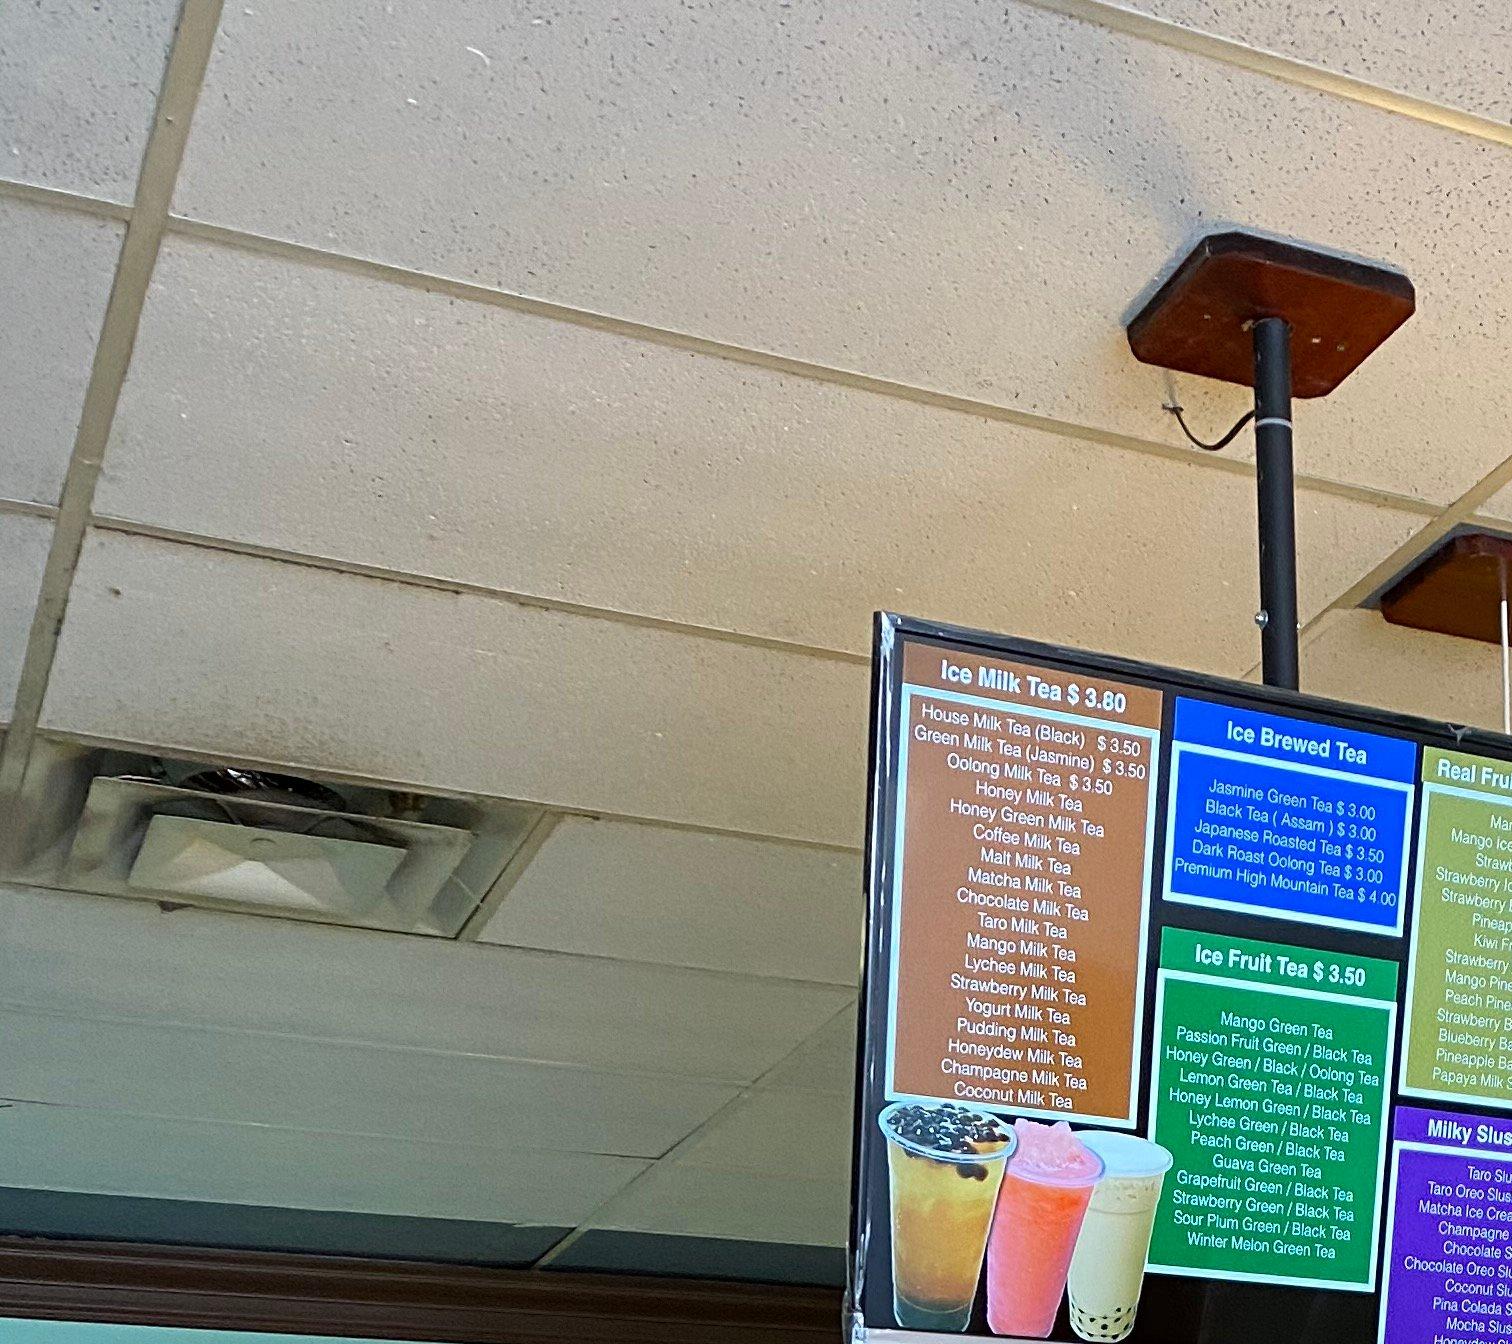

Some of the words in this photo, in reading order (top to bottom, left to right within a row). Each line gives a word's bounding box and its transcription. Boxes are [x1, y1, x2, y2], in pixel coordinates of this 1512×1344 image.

[941, 659, 973, 684] Ice
[977, 665, 1020, 695] Milk
[1027, 675, 1061, 702] Tea
[1066, 683, 1079, 706] $
[1084, 685, 1126, 713] 3.80
[1227, 721, 1254, 742] Ice
[1260, 728, 1330, 757] Brewed
[1336, 741, 1368, 764] Tea
[1437, 760, 1475, 783] Real
[975, 780, 1017, 803] Honey
[1020, 788, 1050, 809] Milk
[1054, 794, 1083, 813] Tea
[1208, 779, 1263, 802] Jasmine
[1268, 790, 1306, 810] Green
[1311, 796, 1333, 813] Tea
[1337, 798, 1345, 817] $
[1349, 802, 1375, 819] 3.00
[1195, 944, 1223, 966] Ice
[1229, 948, 1271, 974] Fruit
[1276, 958, 1308, 977] Tea
[1313, 962, 1324, 982] $
[1329, 963, 1365, 987] 3.50
[1221, 1011, 1264, 1036] Mango
[1269, 1019, 1307, 1037] Green
[1312, 1022, 1333, 1038] Tea
[1428, 1119, 1474, 1147] Milky
